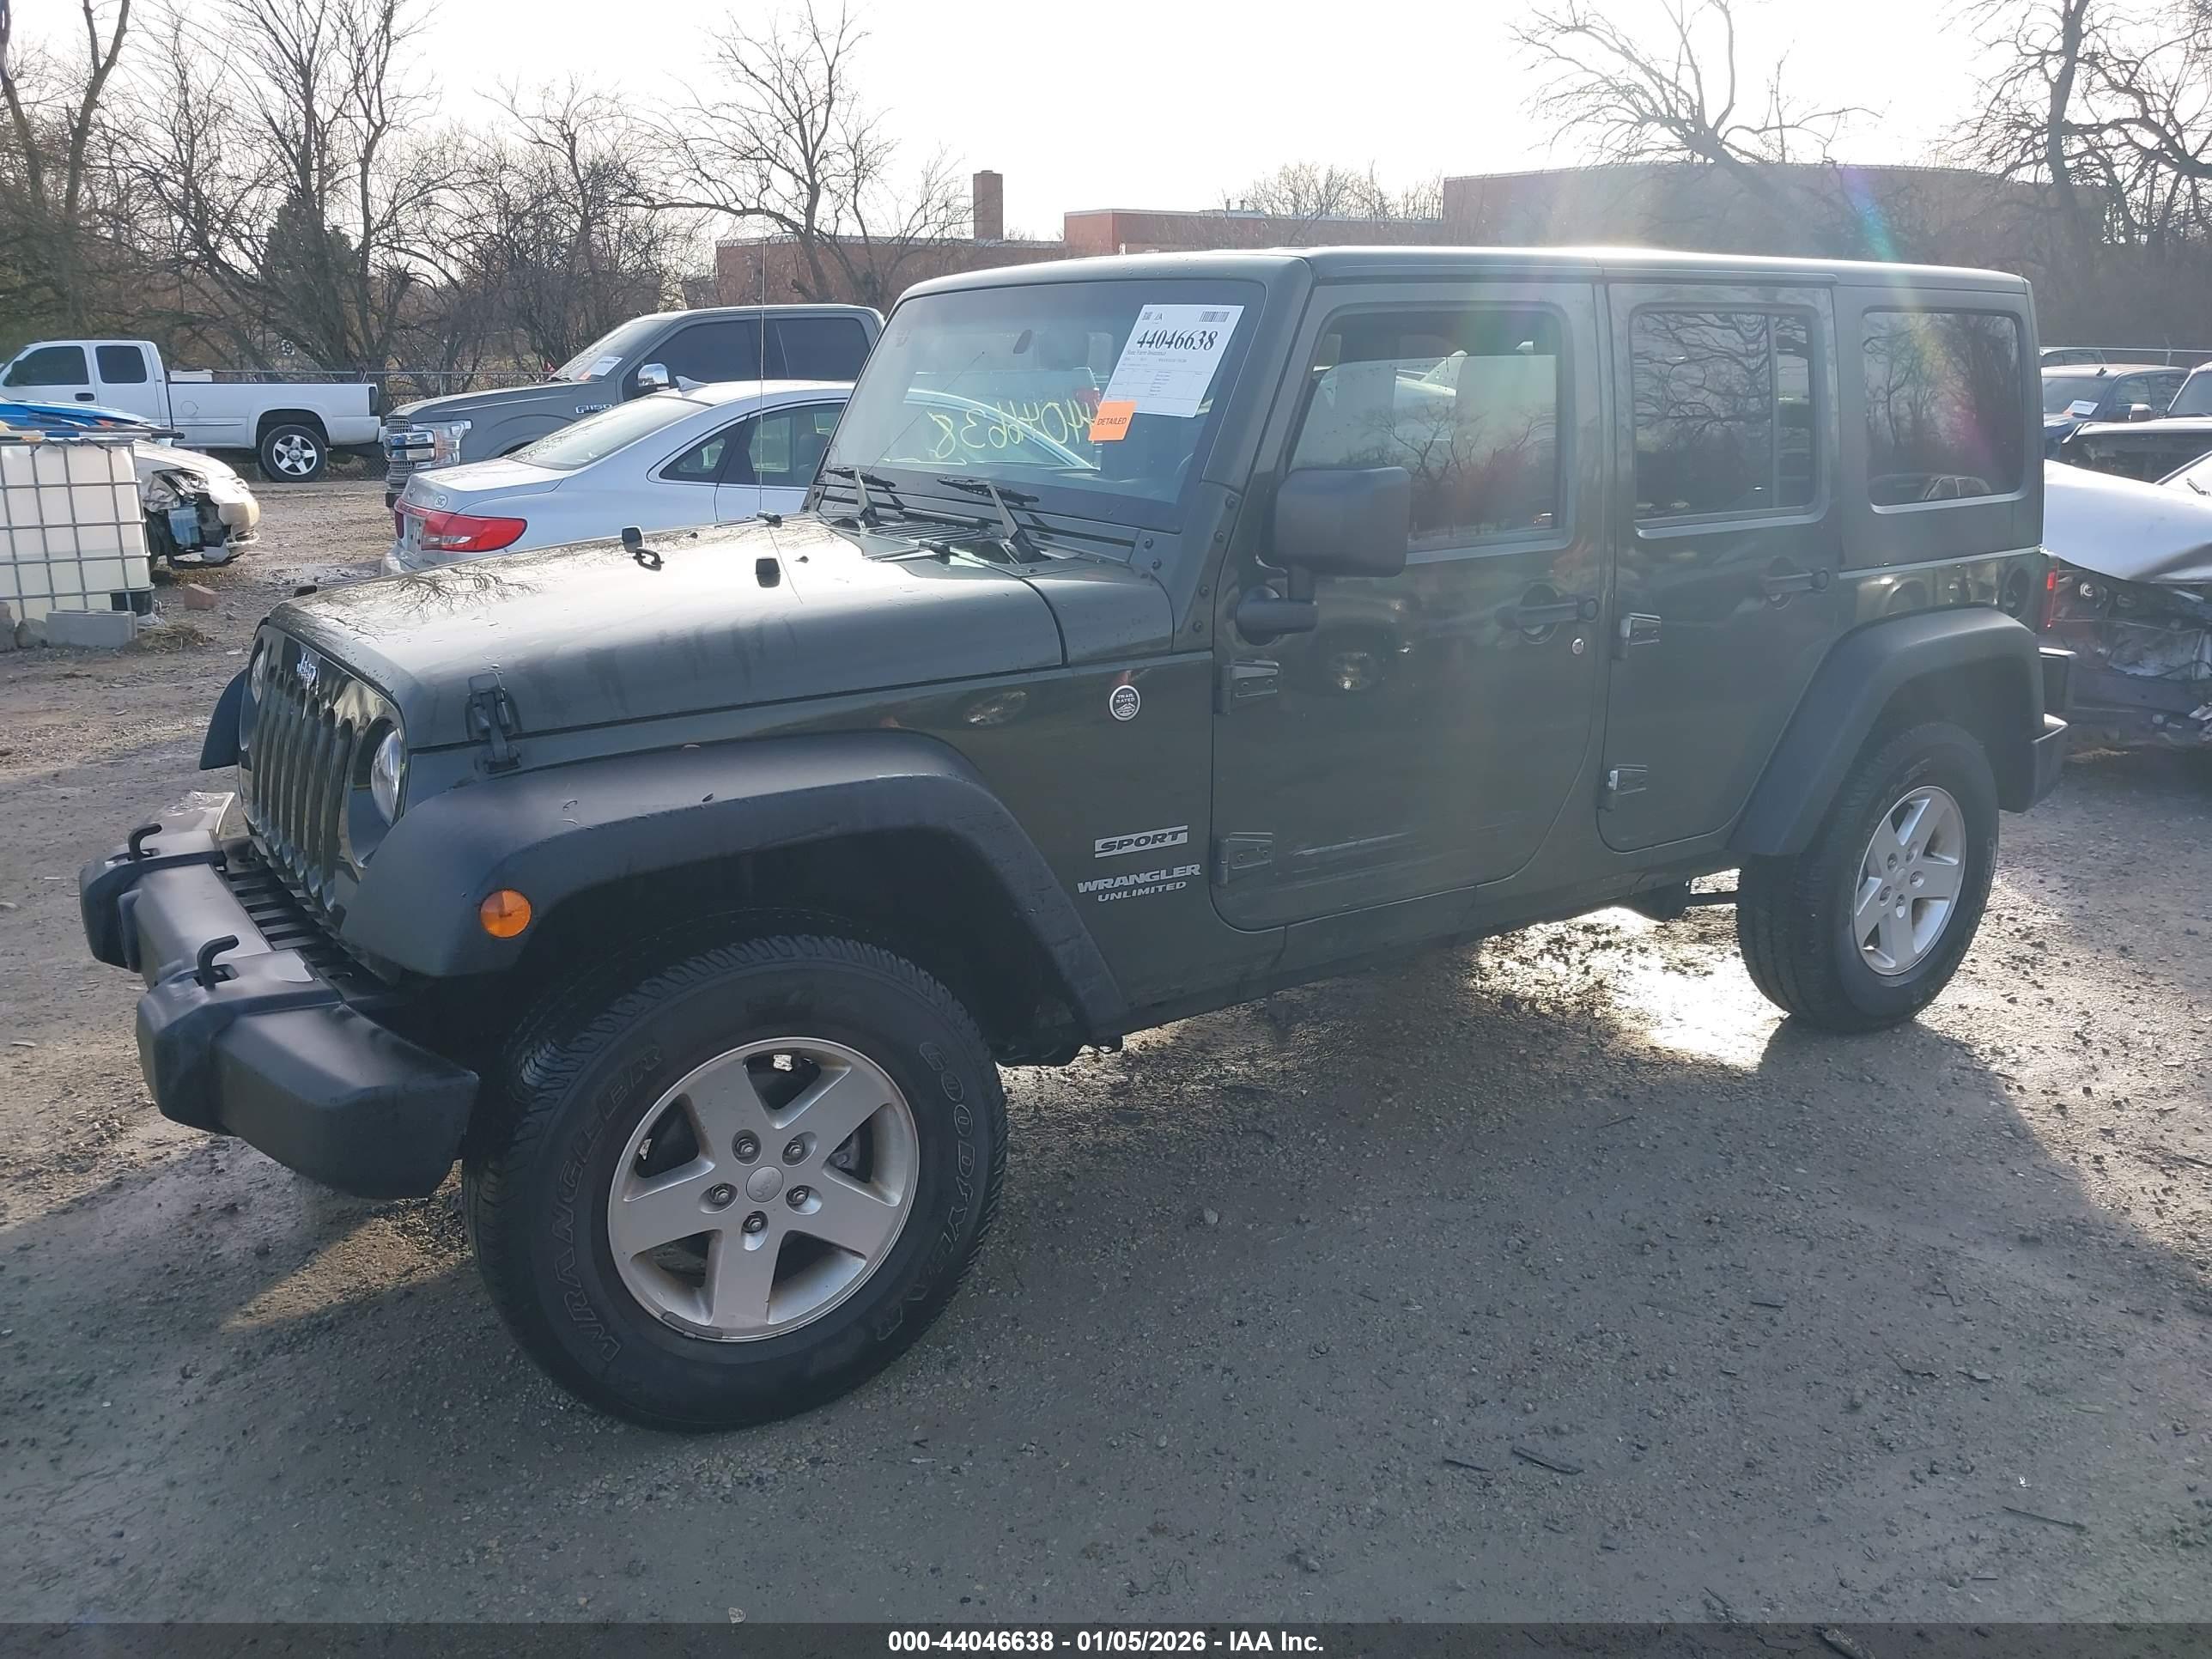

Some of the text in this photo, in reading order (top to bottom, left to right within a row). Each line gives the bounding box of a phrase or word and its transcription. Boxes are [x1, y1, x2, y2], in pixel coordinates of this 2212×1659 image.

[1137, 330, 1218, 350] 44046638
[1097, 417, 1127, 426] DETAILED
[1097, 829, 1188, 854] SPORT
[1077, 864, 1201, 893] WRANGLER
[1097, 881, 1187, 902] UNLIMITED
[550, 1042, 664, 1363] WRANGLER
